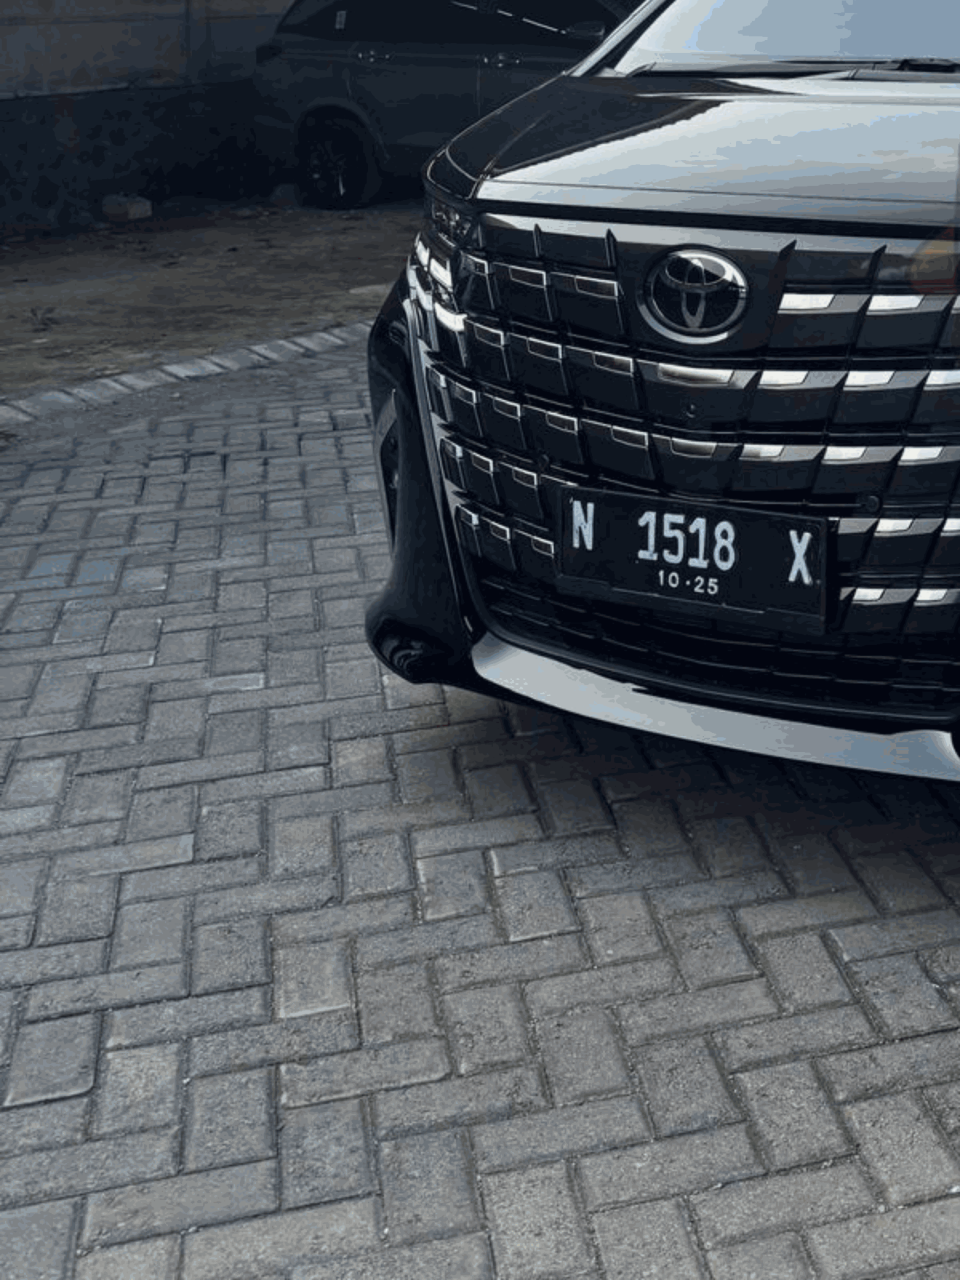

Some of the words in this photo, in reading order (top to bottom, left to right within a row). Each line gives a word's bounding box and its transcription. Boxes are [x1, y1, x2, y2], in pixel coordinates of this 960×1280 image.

[572, 500, 594, 551] N
[637, 511, 736, 571] 1518
[788, 529, 813, 585] X
